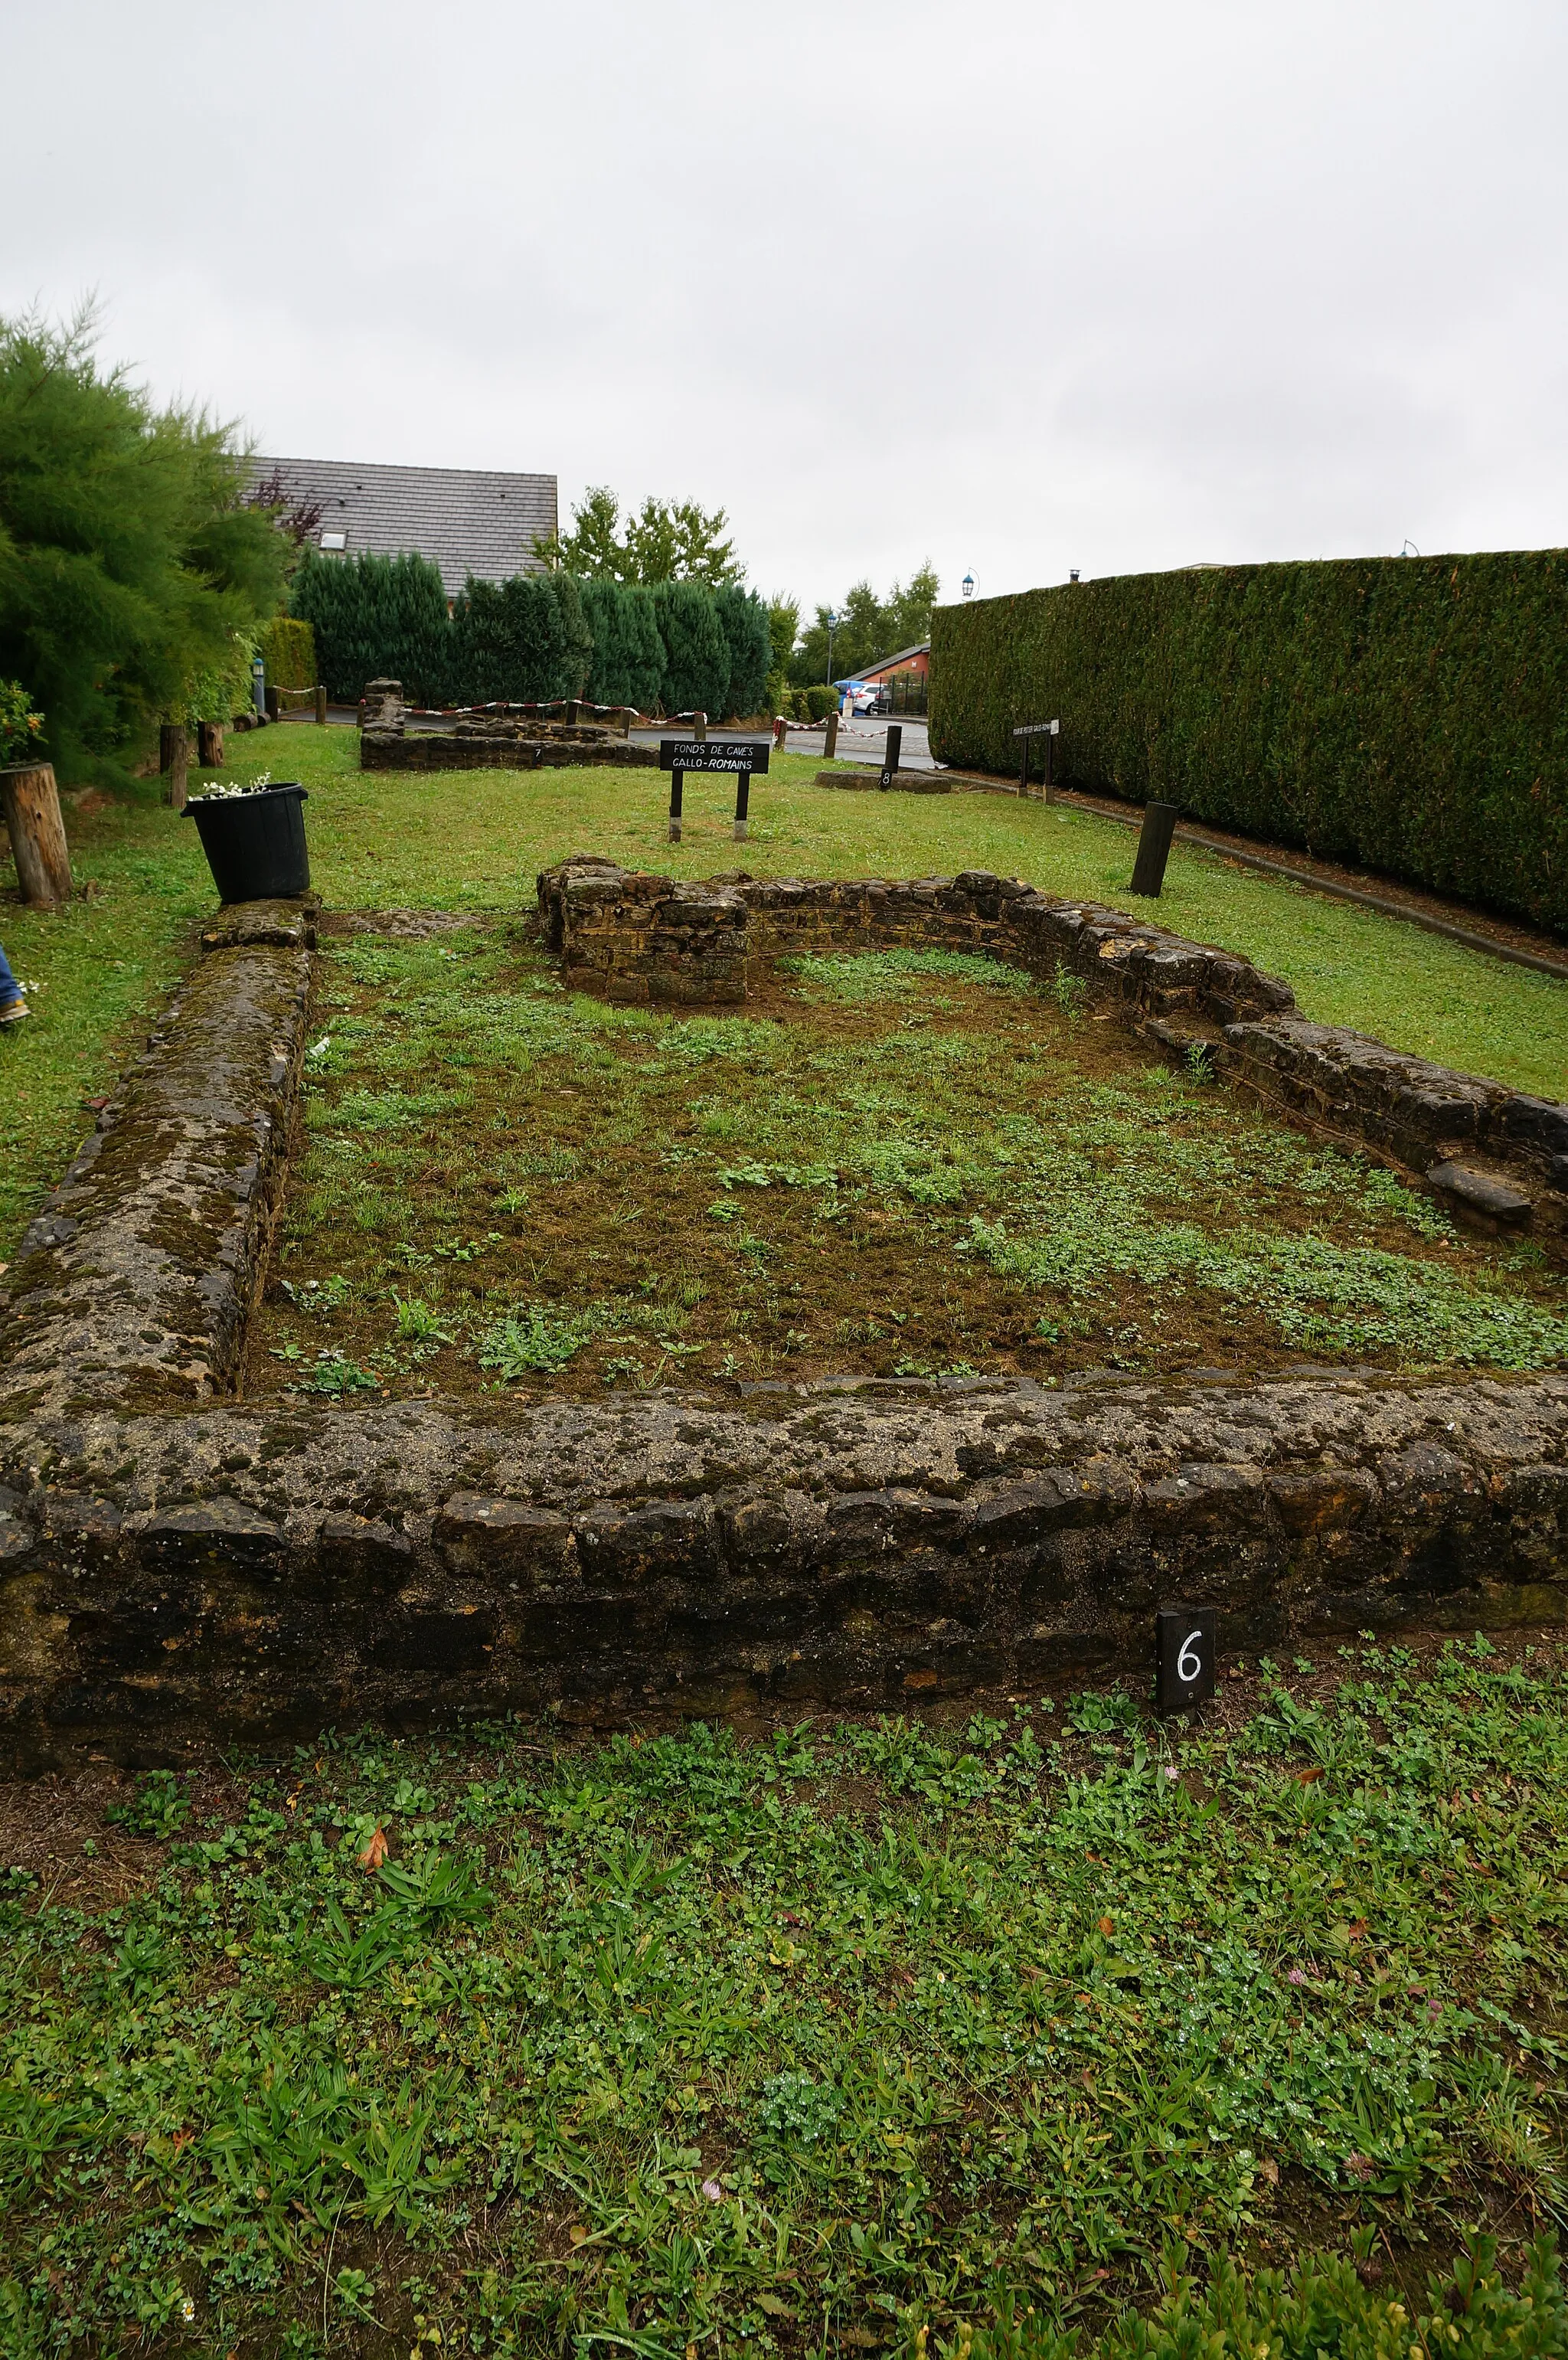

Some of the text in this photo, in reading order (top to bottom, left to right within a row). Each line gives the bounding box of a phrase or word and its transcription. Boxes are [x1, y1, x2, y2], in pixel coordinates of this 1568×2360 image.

[674, 744, 753, 756] FONDS DE CAVES
[672, 758, 753, 770] GALLO-ROMAINS
[883, 773, 890, 784] 8
[1178, 1630, 1202, 1682] 6
